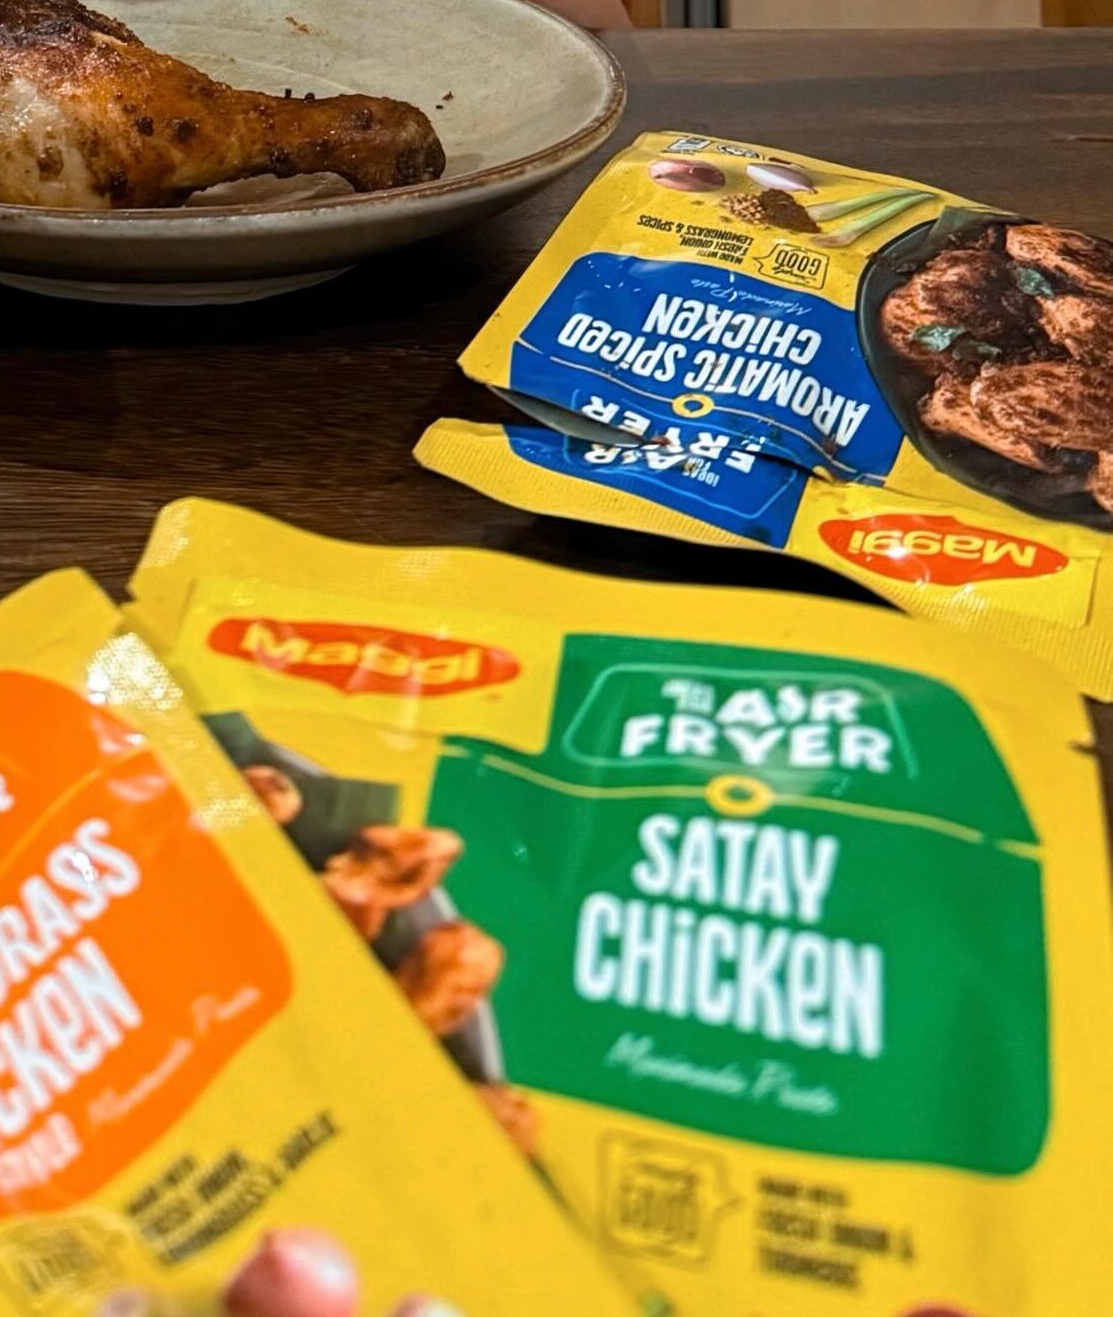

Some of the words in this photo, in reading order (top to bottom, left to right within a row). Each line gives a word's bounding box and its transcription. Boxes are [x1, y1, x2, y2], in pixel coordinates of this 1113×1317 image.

[774, 249, 822, 276] GOOD
[849, 528, 1038, 568] Maggi
[241, 620, 482, 686] Maggi
[619, 711, 893, 774] FRYER
[631, 812, 840, 925] SATAY
